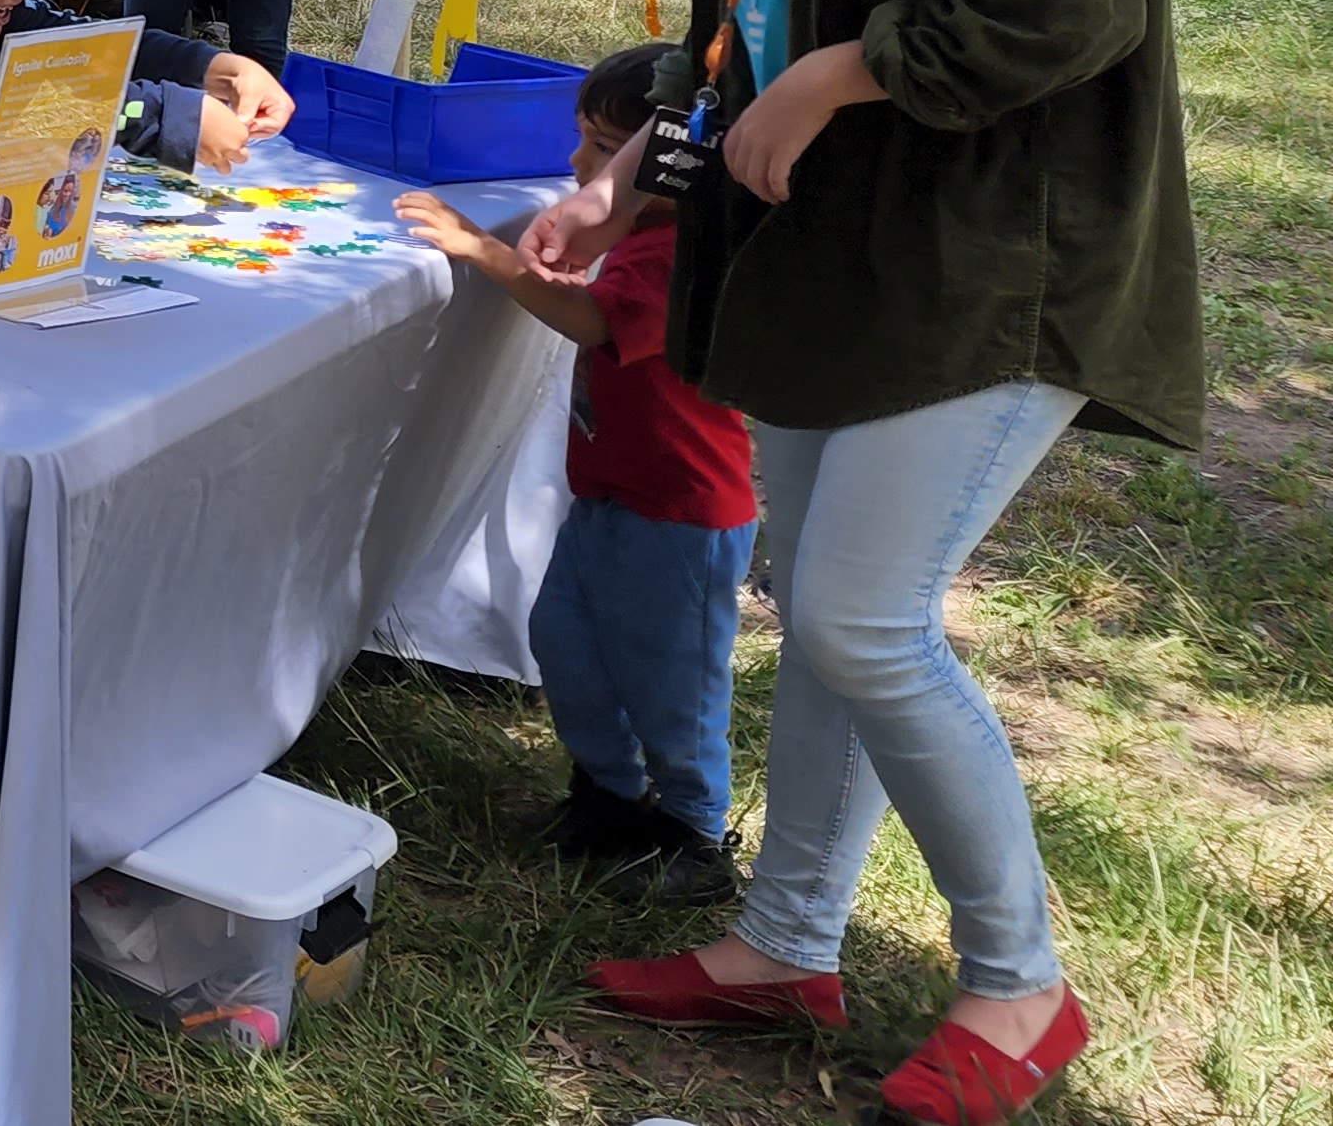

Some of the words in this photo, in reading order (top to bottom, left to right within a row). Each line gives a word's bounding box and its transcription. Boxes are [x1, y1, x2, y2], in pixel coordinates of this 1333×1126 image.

[13, 59, 43, 77] Ignite
[45, 52, 92, 69] Curiosity
[36, 236, 82, 268] moxi
